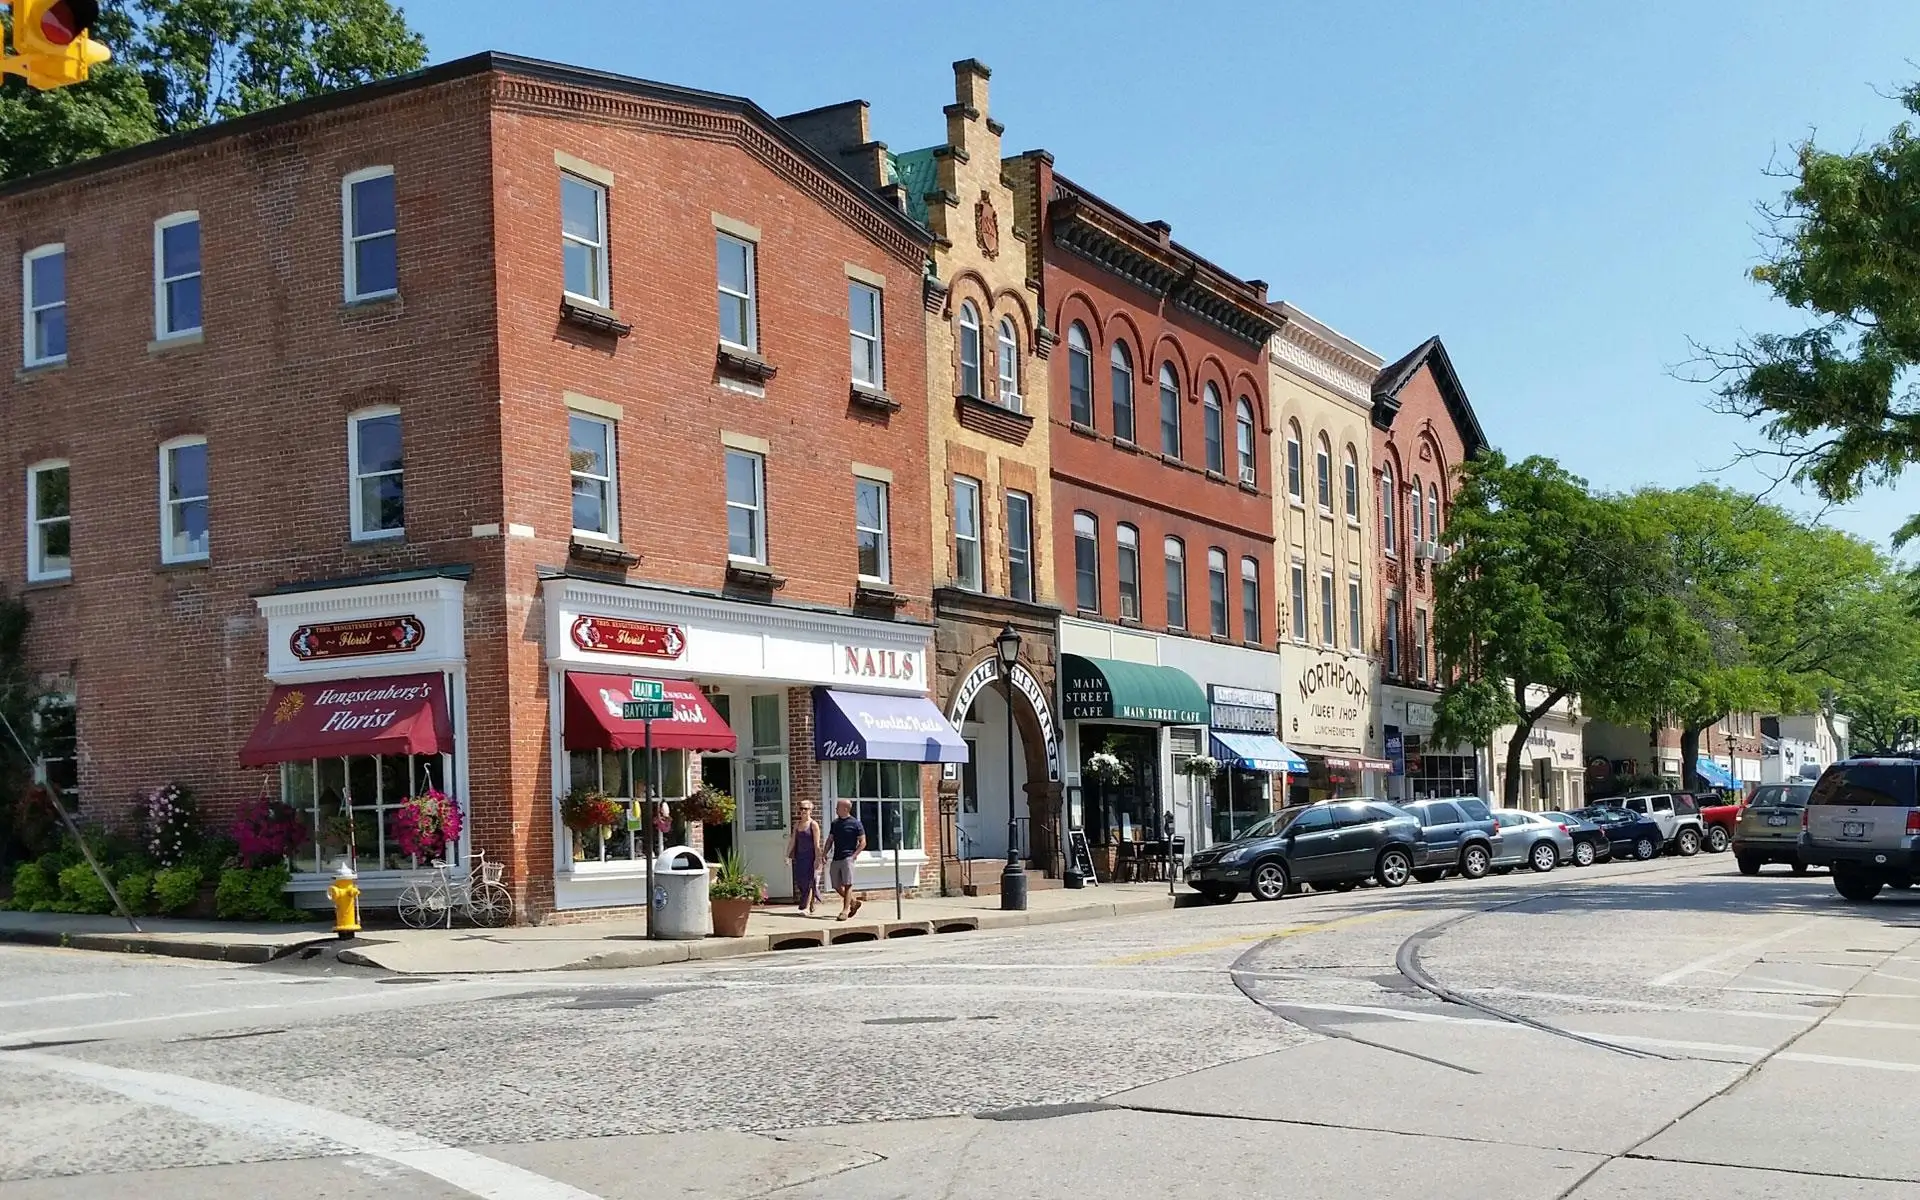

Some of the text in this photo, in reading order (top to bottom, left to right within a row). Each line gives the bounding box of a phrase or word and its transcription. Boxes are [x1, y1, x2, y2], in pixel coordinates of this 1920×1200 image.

[339, 631, 372, 647] Florist
[616, 629, 646, 646] Florist
[845, 646, 914, 680] NAILS
[634, 682, 653, 697] MAIN
[1073, 678, 1103, 689] MAIN
[1299, 662, 1368, 711] NORTHPORT
[313, 682, 432, 706] Hengstenberg's
[1066, 691, 1109, 702] STREET
[624, 703, 672, 717] BAYVIEW AVE
[1073, 706, 1103, 717] CAFE
[1123, 705, 1145, 717] MAIN
[1148, 708, 1177, 720] STREET
[1181, 711, 1200, 722] CAFE
[1311, 703, 1357, 720] SWEET SHOP
[320, 708, 398, 732] Florist
[823, 740, 860, 758] Nails
